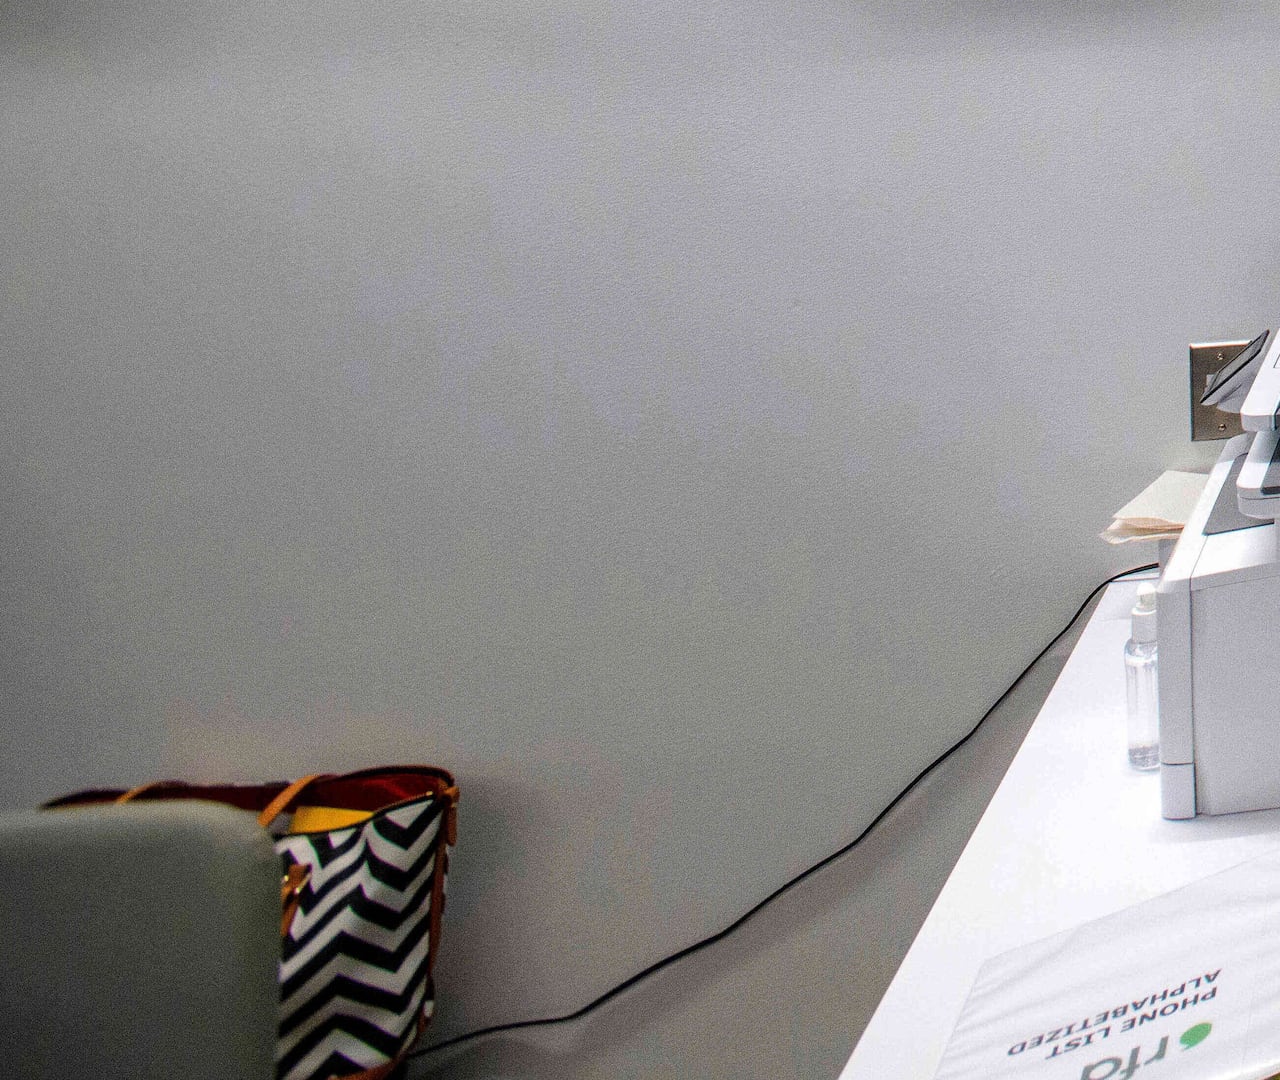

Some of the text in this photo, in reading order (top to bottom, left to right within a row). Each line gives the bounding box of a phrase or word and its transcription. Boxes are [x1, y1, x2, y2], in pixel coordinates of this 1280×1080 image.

[1007, 968, 1222, 1056] ALPHABETIZED
[1045, 986, 1218, 1060] PHONE LIST
